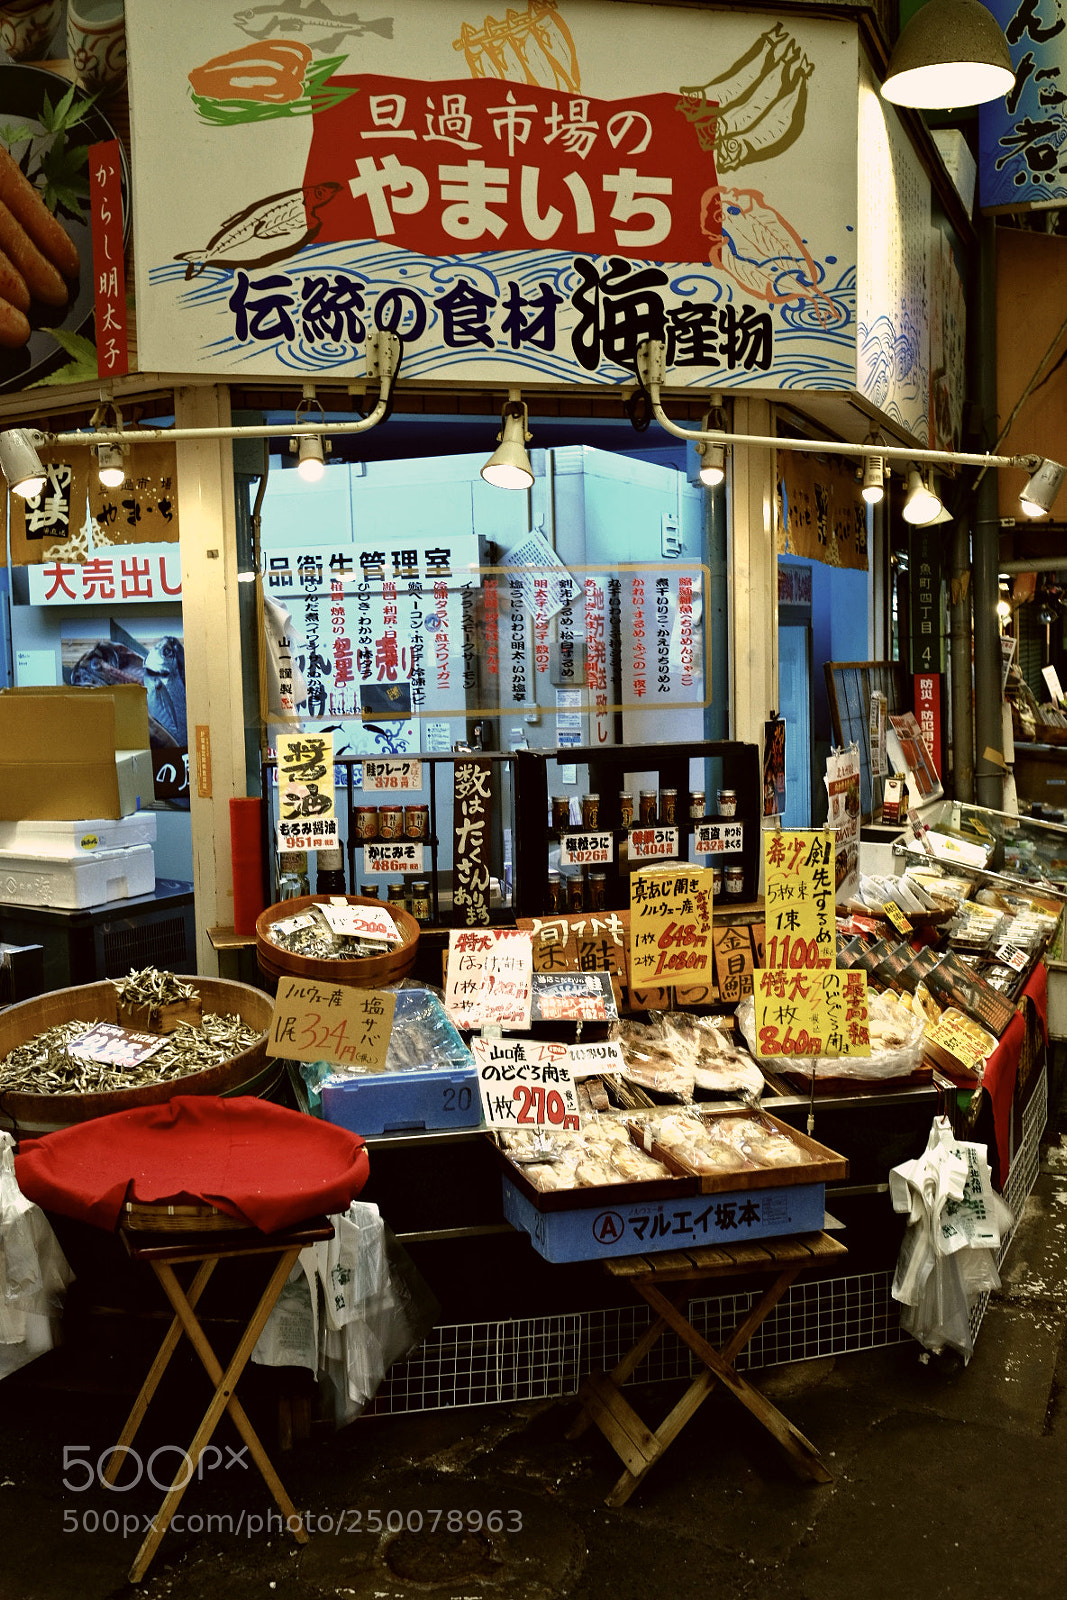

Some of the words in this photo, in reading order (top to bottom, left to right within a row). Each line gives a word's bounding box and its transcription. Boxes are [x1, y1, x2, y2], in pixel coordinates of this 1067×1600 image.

[360, 90, 653, 158] 旦過市場の
[348, 153, 673, 248] やまいち
[94, 163, 121, 369] からし明太子
[43, 556, 182, 600] 大売出し
[919, 563, 933, 635] 魚町四丁目
[279, 821, 337, 836] もろみ醤油
[368, 845, 416, 859] かにみそ
[766, 837, 806, 875] 希少
[631, 877, 700, 904] 真あじ開き
[803, 835, 833, 944] 剣先するめ
[640, 898, 694, 917] ノルウェー産
[776, 909, 801, 932] 1束
[453, 932, 493, 953] 特大
[636, 931, 656, 948] 1枚
[657, 921, 708, 950] 648円
[634, 954, 656, 968] 2枚
[715, 927, 753, 1001] 金目鯛
[285, 983, 344, 1008] ノルウェー産
[759, 970, 811, 1002] 特大
[360, 996, 385, 1047] 塩サバ
[763, 1005, 801, 1026] 1枚
[822, 975, 850, 1056] のどぐろ開き
[275, 1015, 297, 1043] 1尾
[298, 1012, 357, 1062] 324円
[759, 1025, 822, 1056] 860円
[489, 1043, 527, 1063] 山口産
[481, 1062, 571, 1084] のどぐろ開き
[442, 1086, 472, 1112] 20
[486, 1091, 516, 1122] 1枚
[512, 1085, 580, 1131] 270円
[628, 1199, 761, 1241] マルエイ坂本
